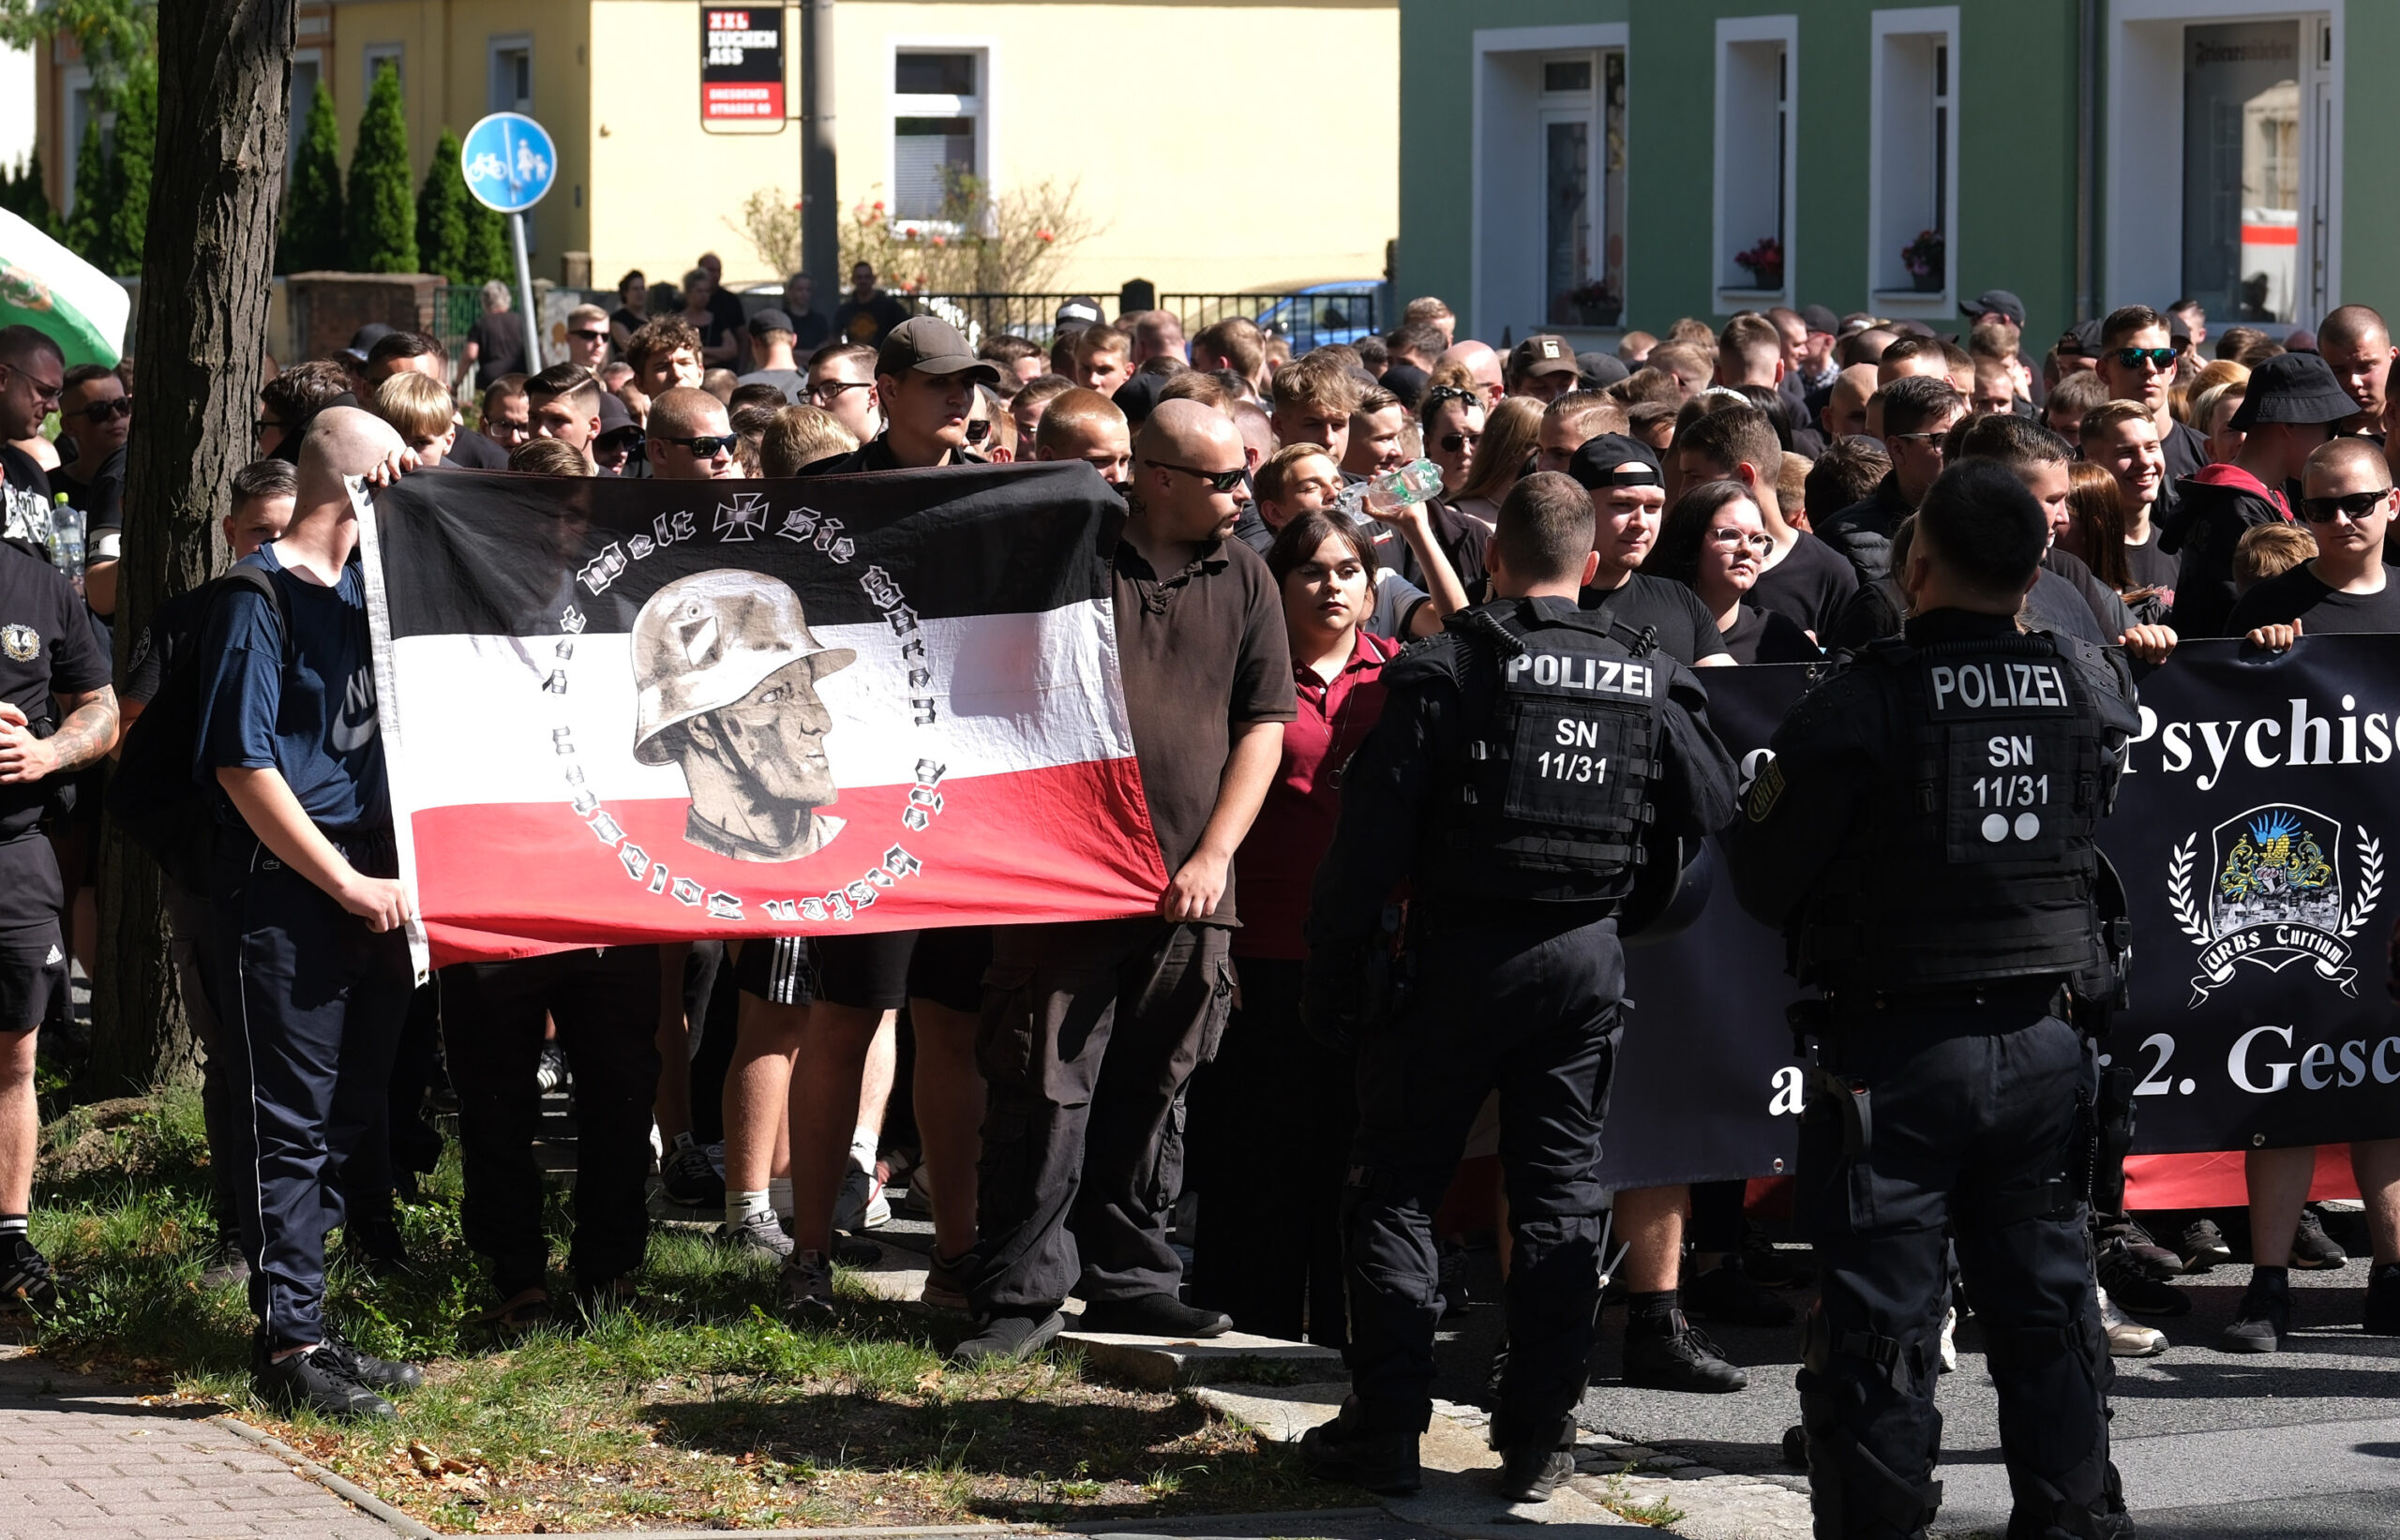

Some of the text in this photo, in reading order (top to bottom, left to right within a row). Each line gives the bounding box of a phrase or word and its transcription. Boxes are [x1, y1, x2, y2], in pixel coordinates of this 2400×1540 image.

[710, 12, 749, 30] XXL
[709, 48, 743, 65] ASS
[775, 506, 856, 564] Sie
[542, 605, 587, 695] der
[1508, 654, 1653, 698] POLIZEI
[1931, 664, 2068, 710] POLIZEI
[1555, 718, 1598, 748] SN
[1988, 735, 2033, 768] SN
[2122, 694, 2400, 791] Psychis
[1538, 751, 1607, 785] 11/31
[902, 758, 946, 832] die
[1972, 774, 2048, 808] 11/31
[2133, 1033, 2196, 1096] 2.
